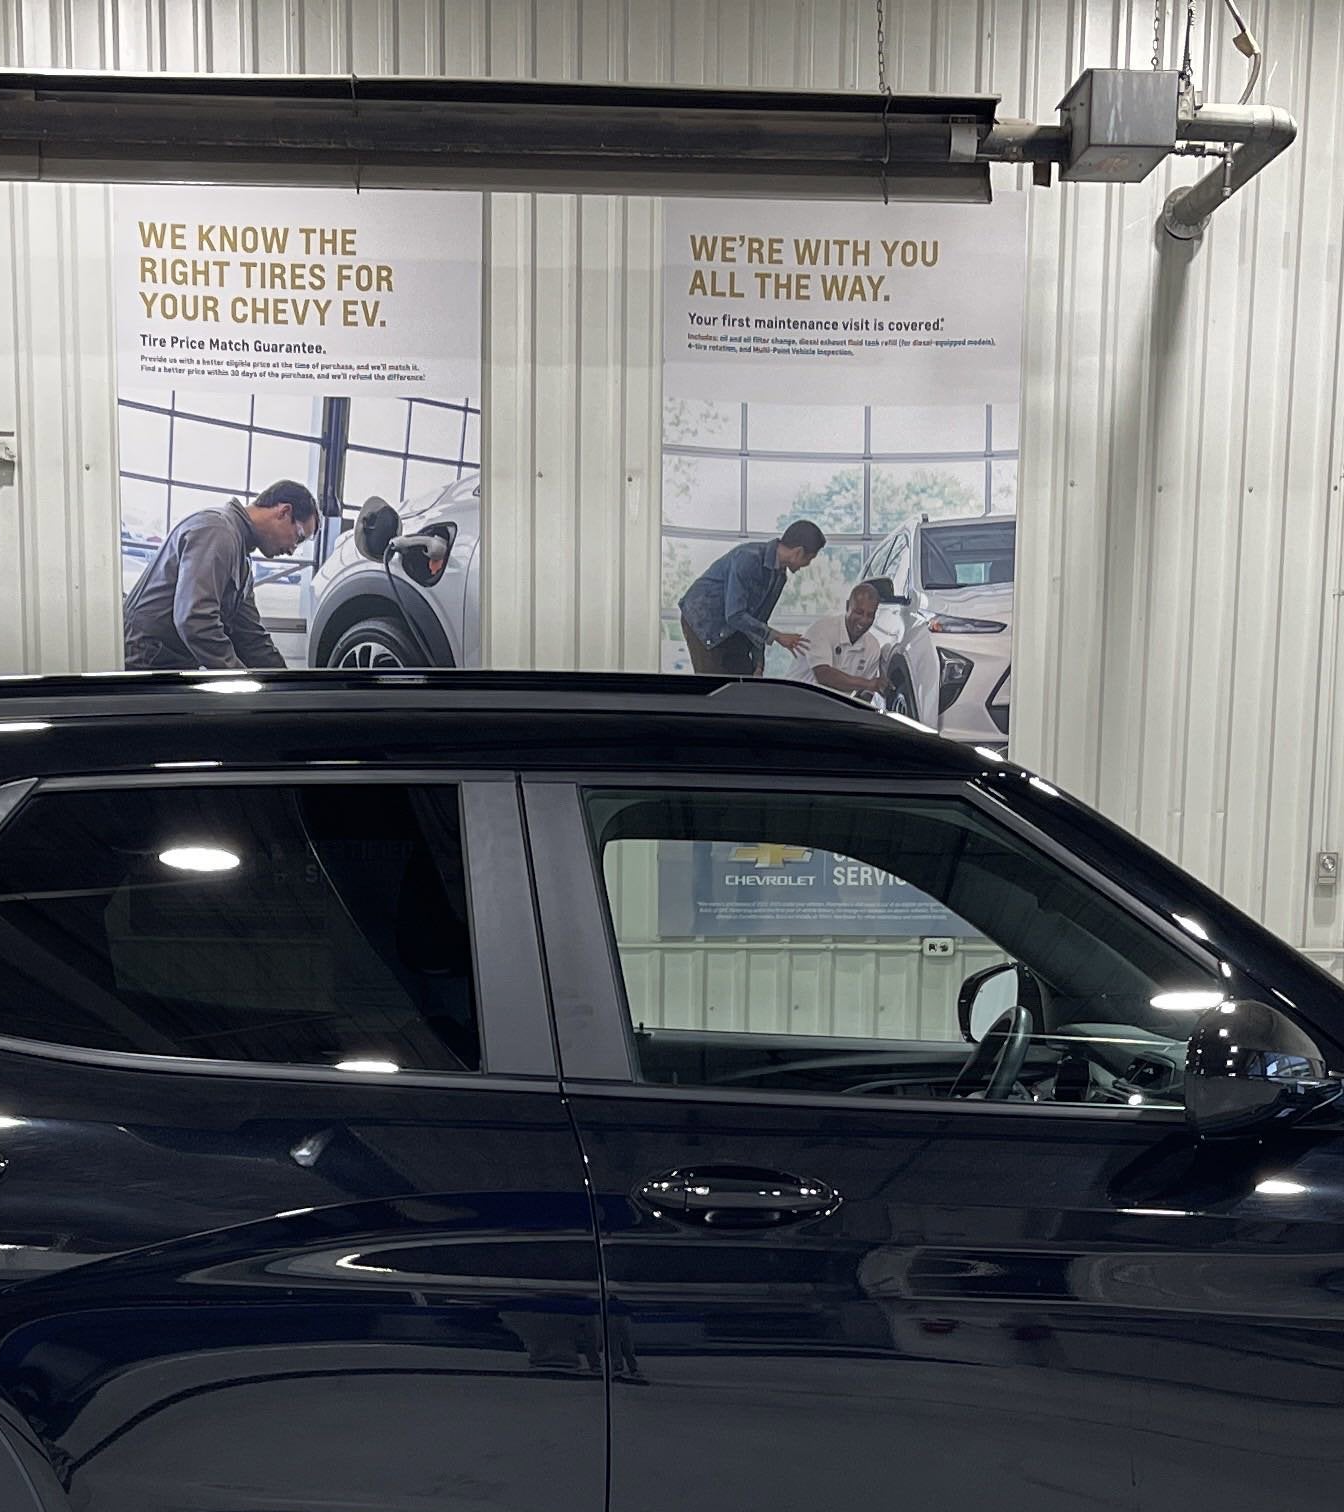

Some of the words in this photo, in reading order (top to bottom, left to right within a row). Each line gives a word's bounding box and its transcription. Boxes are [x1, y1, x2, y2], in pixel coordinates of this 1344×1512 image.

[138, 220, 187, 250] WE
[197, 224, 290, 254] KNOW
[298, 228, 357, 256] THE
[689, 234, 784, 265] WE'RE
[793, 238, 871, 267] WITH
[880, 240, 939, 267] YOU
[139, 256, 231, 288] RIGHT
[239, 261, 326, 291] TIRES
[337, 263, 394, 292] FOR
[688, 269, 745, 299] ALL
[754, 272, 811, 300] THE
[820, 275, 890, 302] WAY.
[138, 291, 220, 322] YOUR
[231, 296, 332, 326] CHEVY
[342, 299, 387, 328] EV.
[688, 312, 718, 327] Your
[721, 314, 751, 328] first
[754, 316, 839, 331] maintenance
[842, 317, 870, 332] visit
[873, 317, 885, 332] is
[139, 334, 167, 348] Tire
[170, 335, 205, 350] Price
[209, 338, 250, 352] Match
[253, 339, 327, 355] Guarantee.
[140, 354, 167, 363] Provide
[179, 357, 195, 365] with
[202, 358, 224, 366] better
[252, 361, 271, 369] price
[311, 362, 320, 370] of
[388, 363, 411, 371] match
[140, 364, 156, 372] Find
[163, 366, 186, 374] better
[187, 367, 205, 376] price
[241, 370, 258, 379] days
[316, 372, 330, 380] and
[725, 875, 816, 886] CHEVROLET
